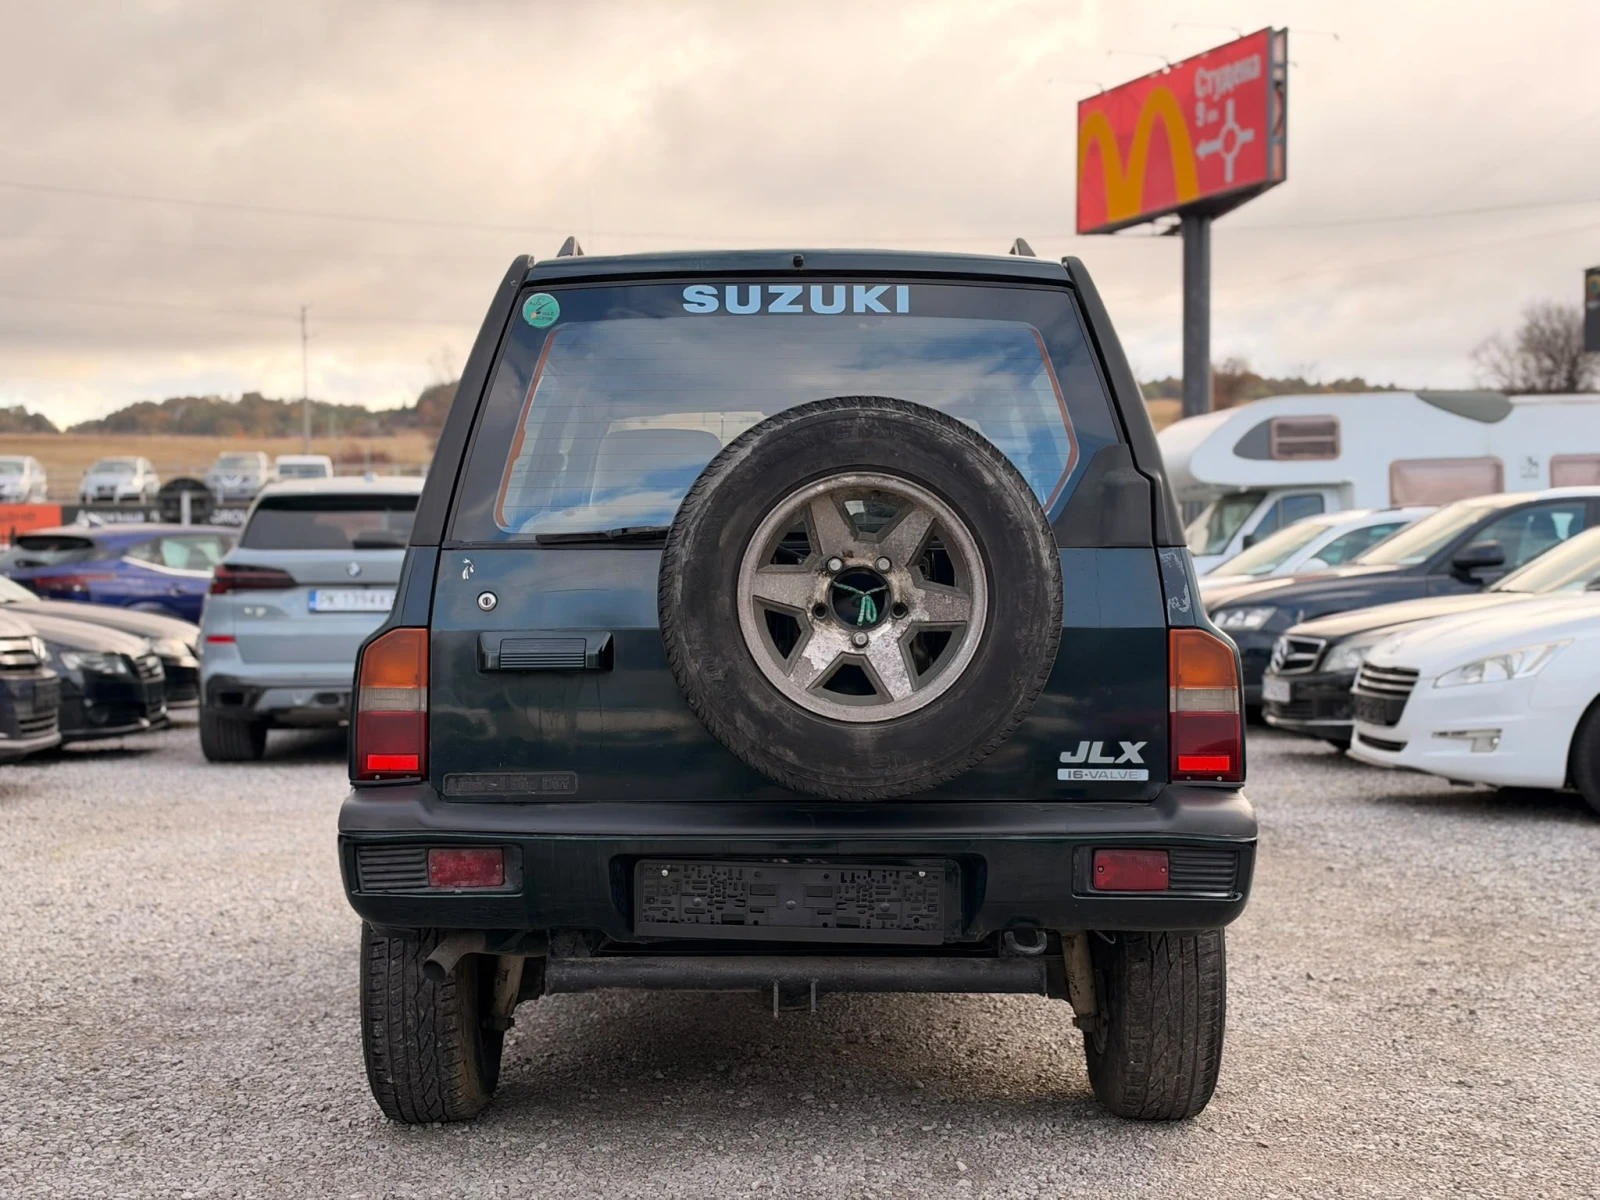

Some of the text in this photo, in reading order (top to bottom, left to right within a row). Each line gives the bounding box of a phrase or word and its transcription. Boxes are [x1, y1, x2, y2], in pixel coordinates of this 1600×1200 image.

[682, 284, 910, 315] SUZUKI
[1059, 741, 1147, 764] JLX
[1067, 770, 1138, 780] 16-VALVE
